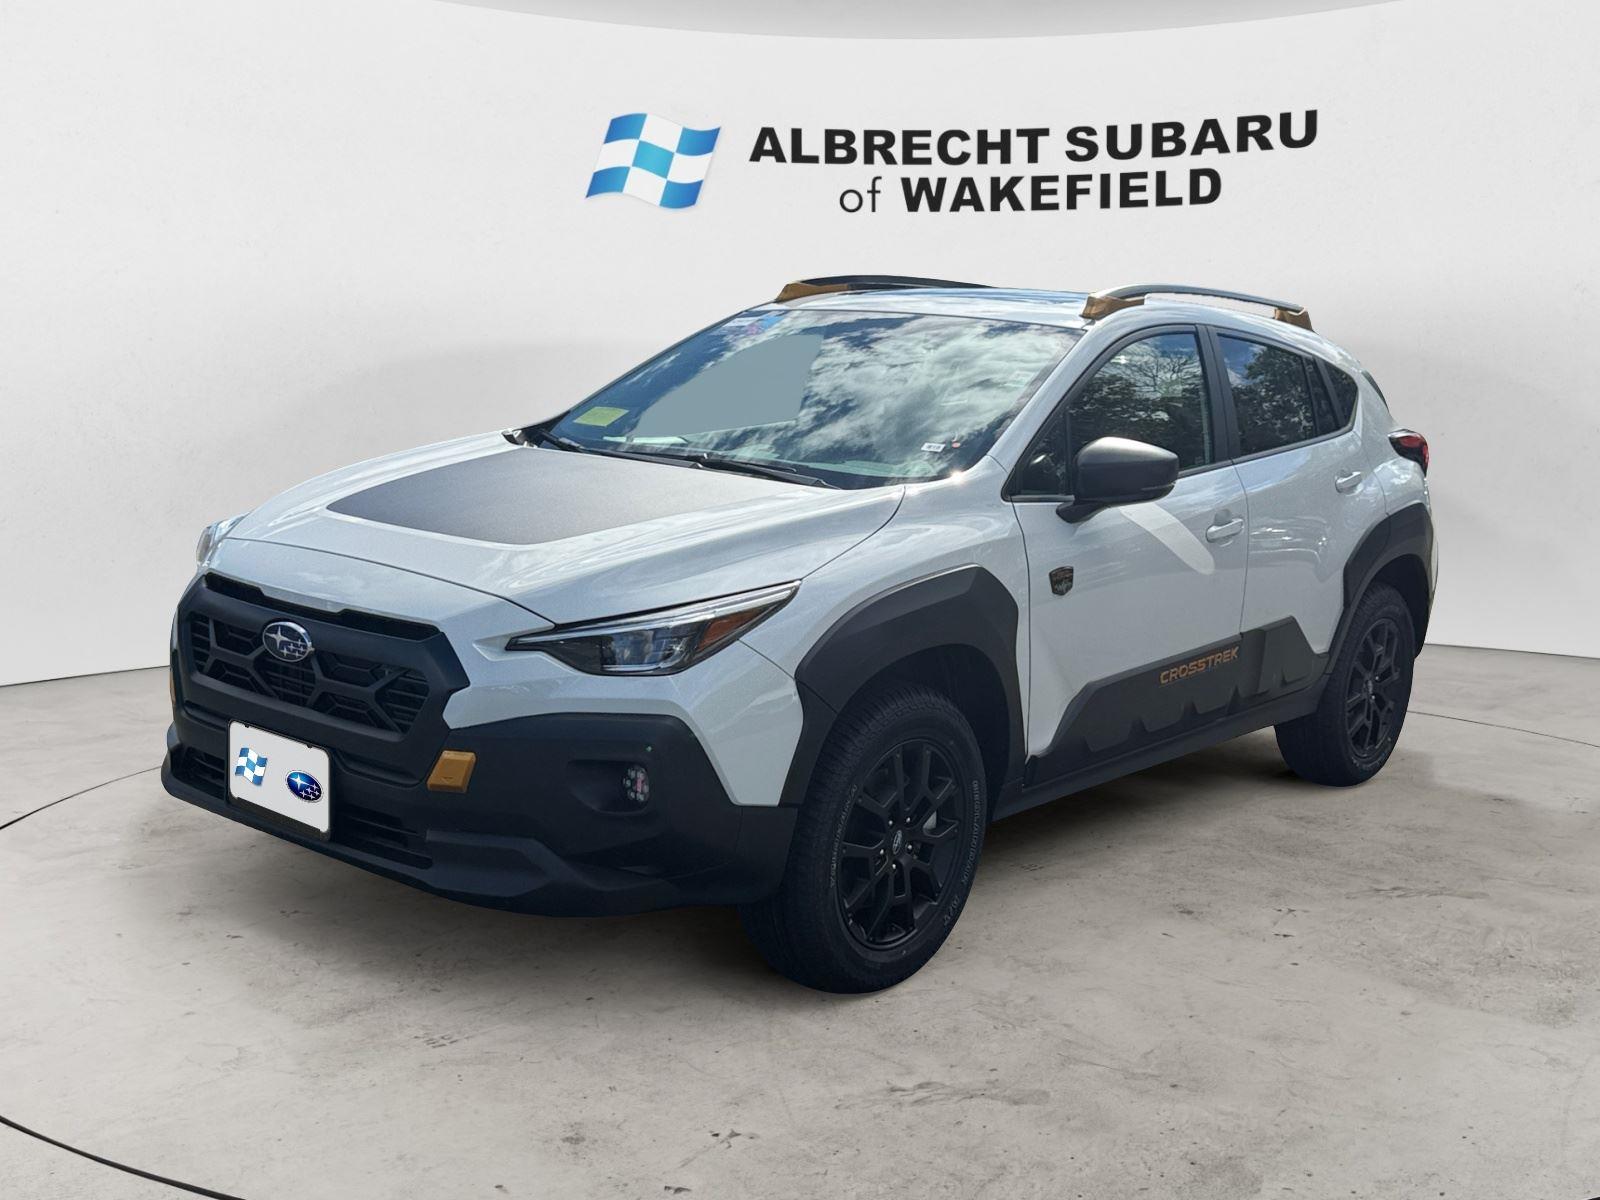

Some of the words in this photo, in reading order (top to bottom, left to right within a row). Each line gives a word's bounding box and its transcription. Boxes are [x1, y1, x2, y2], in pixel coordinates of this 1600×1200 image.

[749, 126, 1050, 166] ALBRECHT
[1065, 109, 1319, 163] SUBARU
[839, 176, 882, 213] of
[901, 167, 1222, 213] WAKEFIELD
[1159, 645, 1240, 684] CROSSTREK
